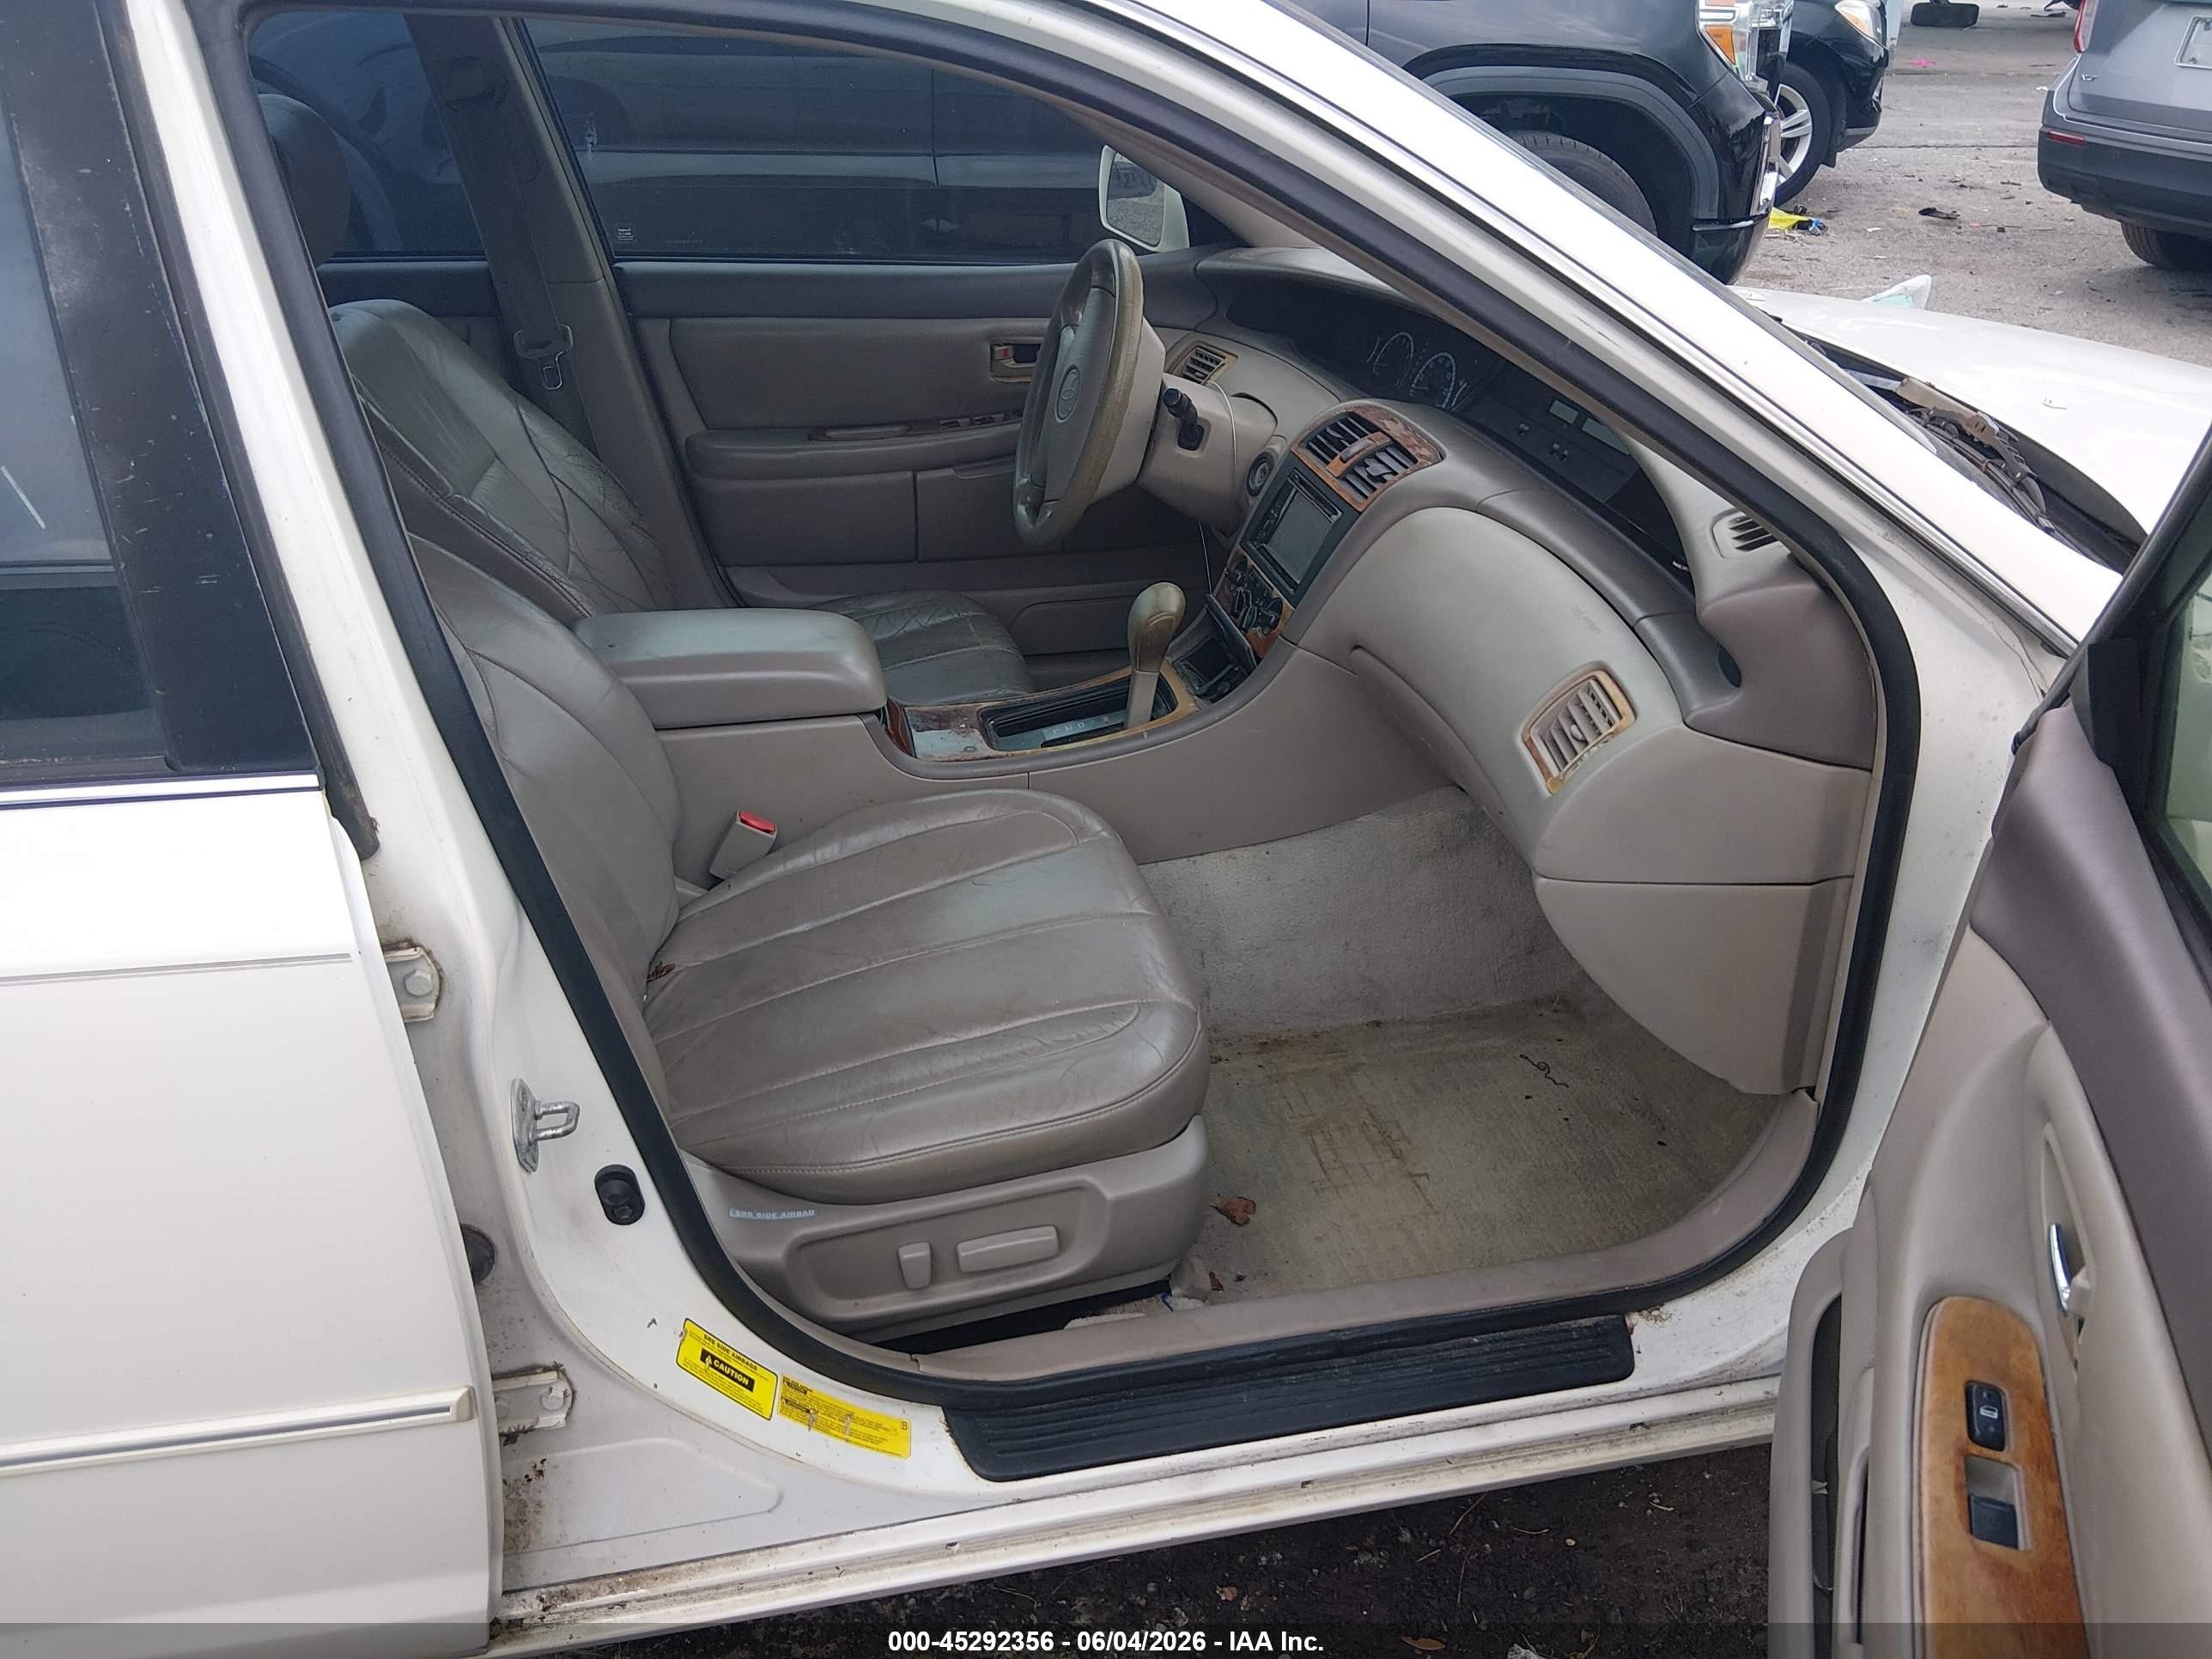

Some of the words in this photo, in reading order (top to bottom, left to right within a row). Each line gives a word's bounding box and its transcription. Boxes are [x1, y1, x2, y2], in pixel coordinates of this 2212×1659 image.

[704, 1334, 715, 1345] SRS
[716, 1342, 731, 1354] SIDE
[732, 1352, 757, 1370] AIRBAGS
[714, 1359, 749, 1385] CAUTION
